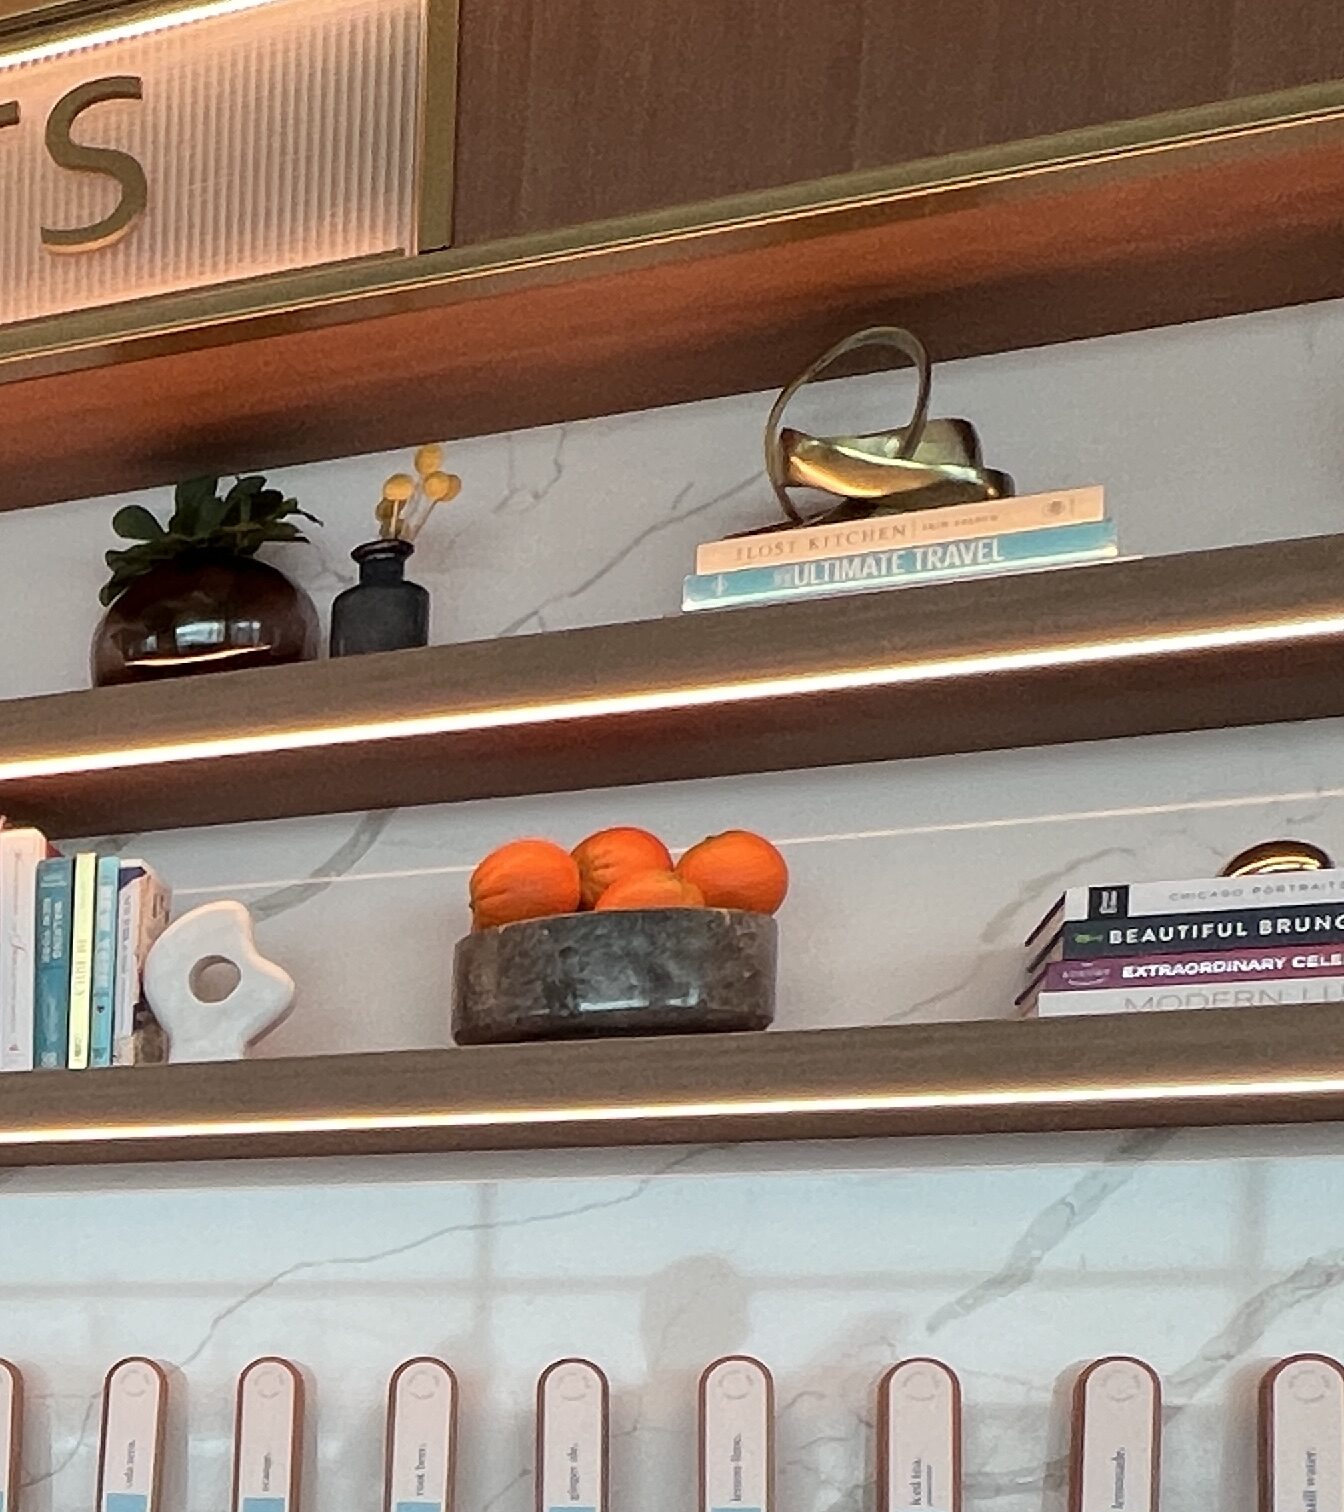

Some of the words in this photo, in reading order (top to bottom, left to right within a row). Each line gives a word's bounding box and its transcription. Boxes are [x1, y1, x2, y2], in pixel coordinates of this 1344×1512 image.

[747, 539, 797, 561] LOST
[808, 525, 907, 551] KITCHEN
[793, 550, 906, 588] ULTIMATE
[914, 538, 1005, 571] TRAVEL
[1169, 888, 1243, 901] CHICAGO
[1109, 922, 1248, 944] BEAUTIFUL
[1122, 956, 1286, 979] EXTRAORDINARY
